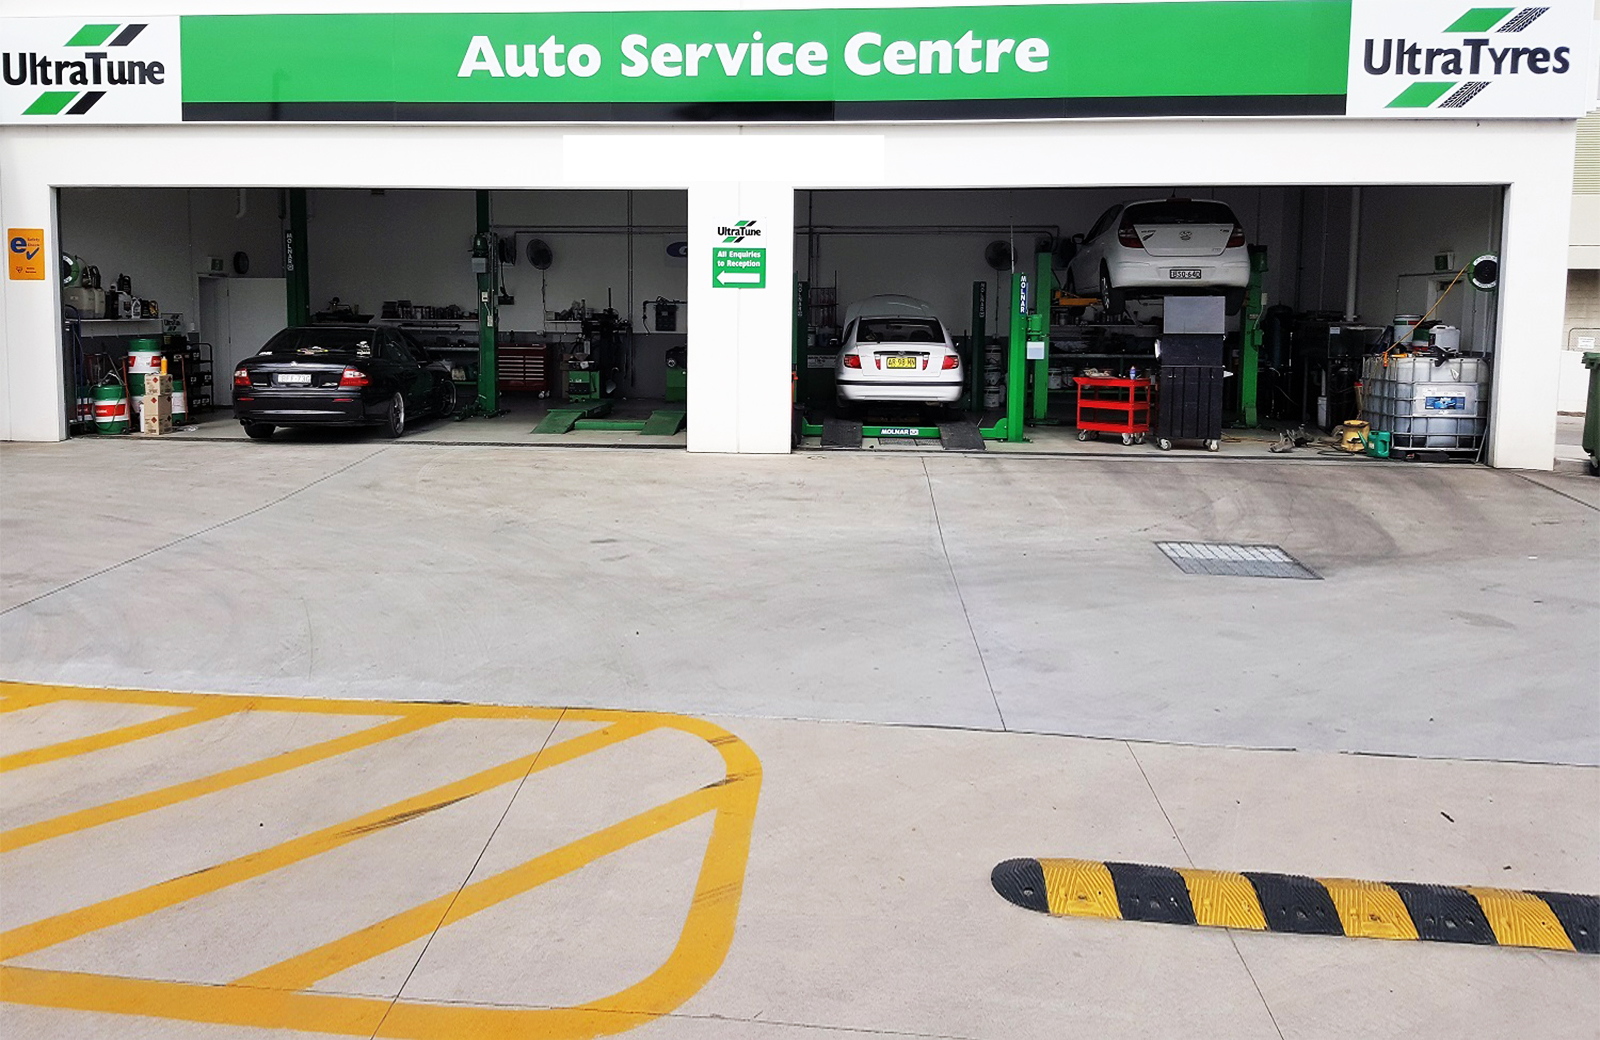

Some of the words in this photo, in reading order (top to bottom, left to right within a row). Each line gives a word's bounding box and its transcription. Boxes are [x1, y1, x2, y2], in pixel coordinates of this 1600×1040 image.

[457, 35, 602, 78] Auto
[620, 30, 827, 77] Service
[844, 29, 1050, 77] Centre
[1363, 38, 1571, 76] UltraTyres
[2, 52, 165, 86] UltraTune
[717, 226, 761, 236] UltraTune
[727, 260, 761, 269] Reception
[729, 251, 761, 259] Enquiries
